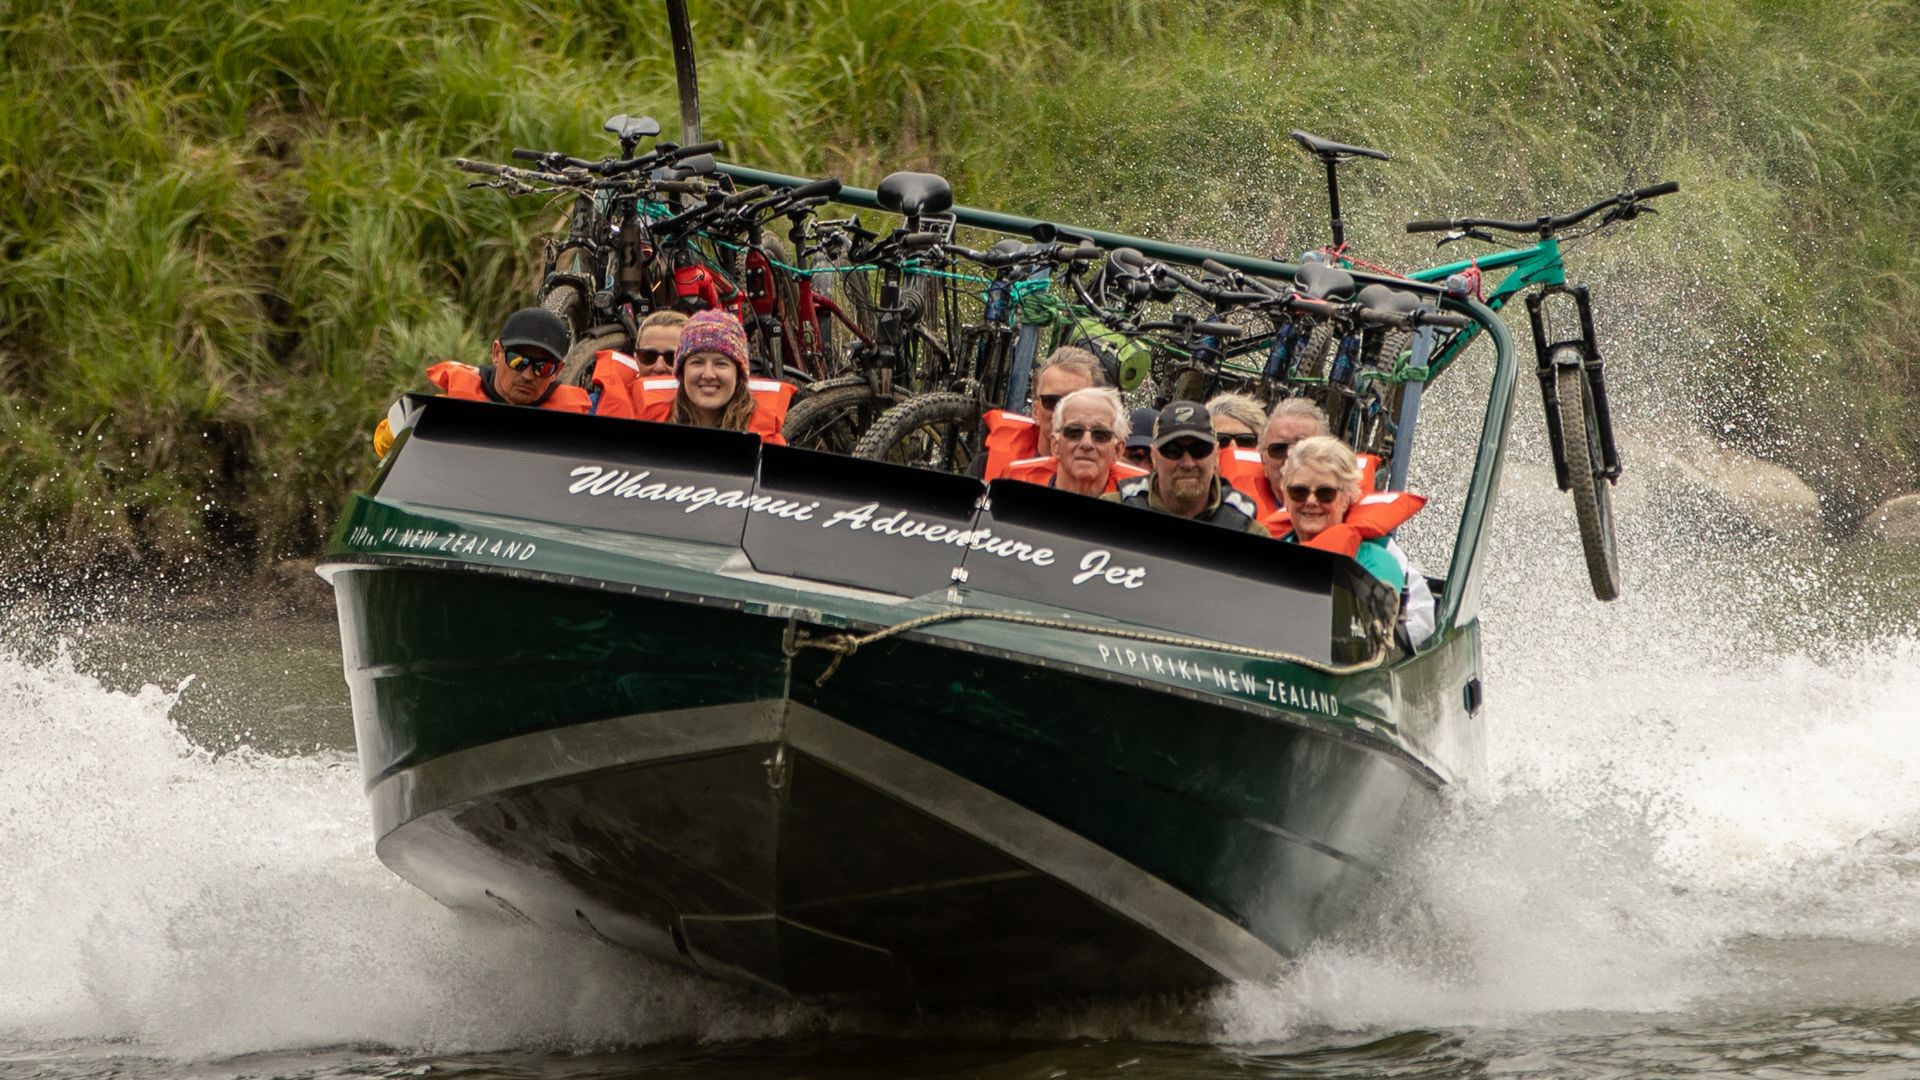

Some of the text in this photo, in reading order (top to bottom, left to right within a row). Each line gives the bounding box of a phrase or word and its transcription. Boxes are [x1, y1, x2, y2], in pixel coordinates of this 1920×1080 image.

[399, 528, 438, 549] NEW
[439, 533, 536, 561] ZEALAND
[568, 465, 1148, 590] Whanganui Adventure Jet
[1098, 644, 1340, 717] PIPIRIKI NEW ZEALAND
